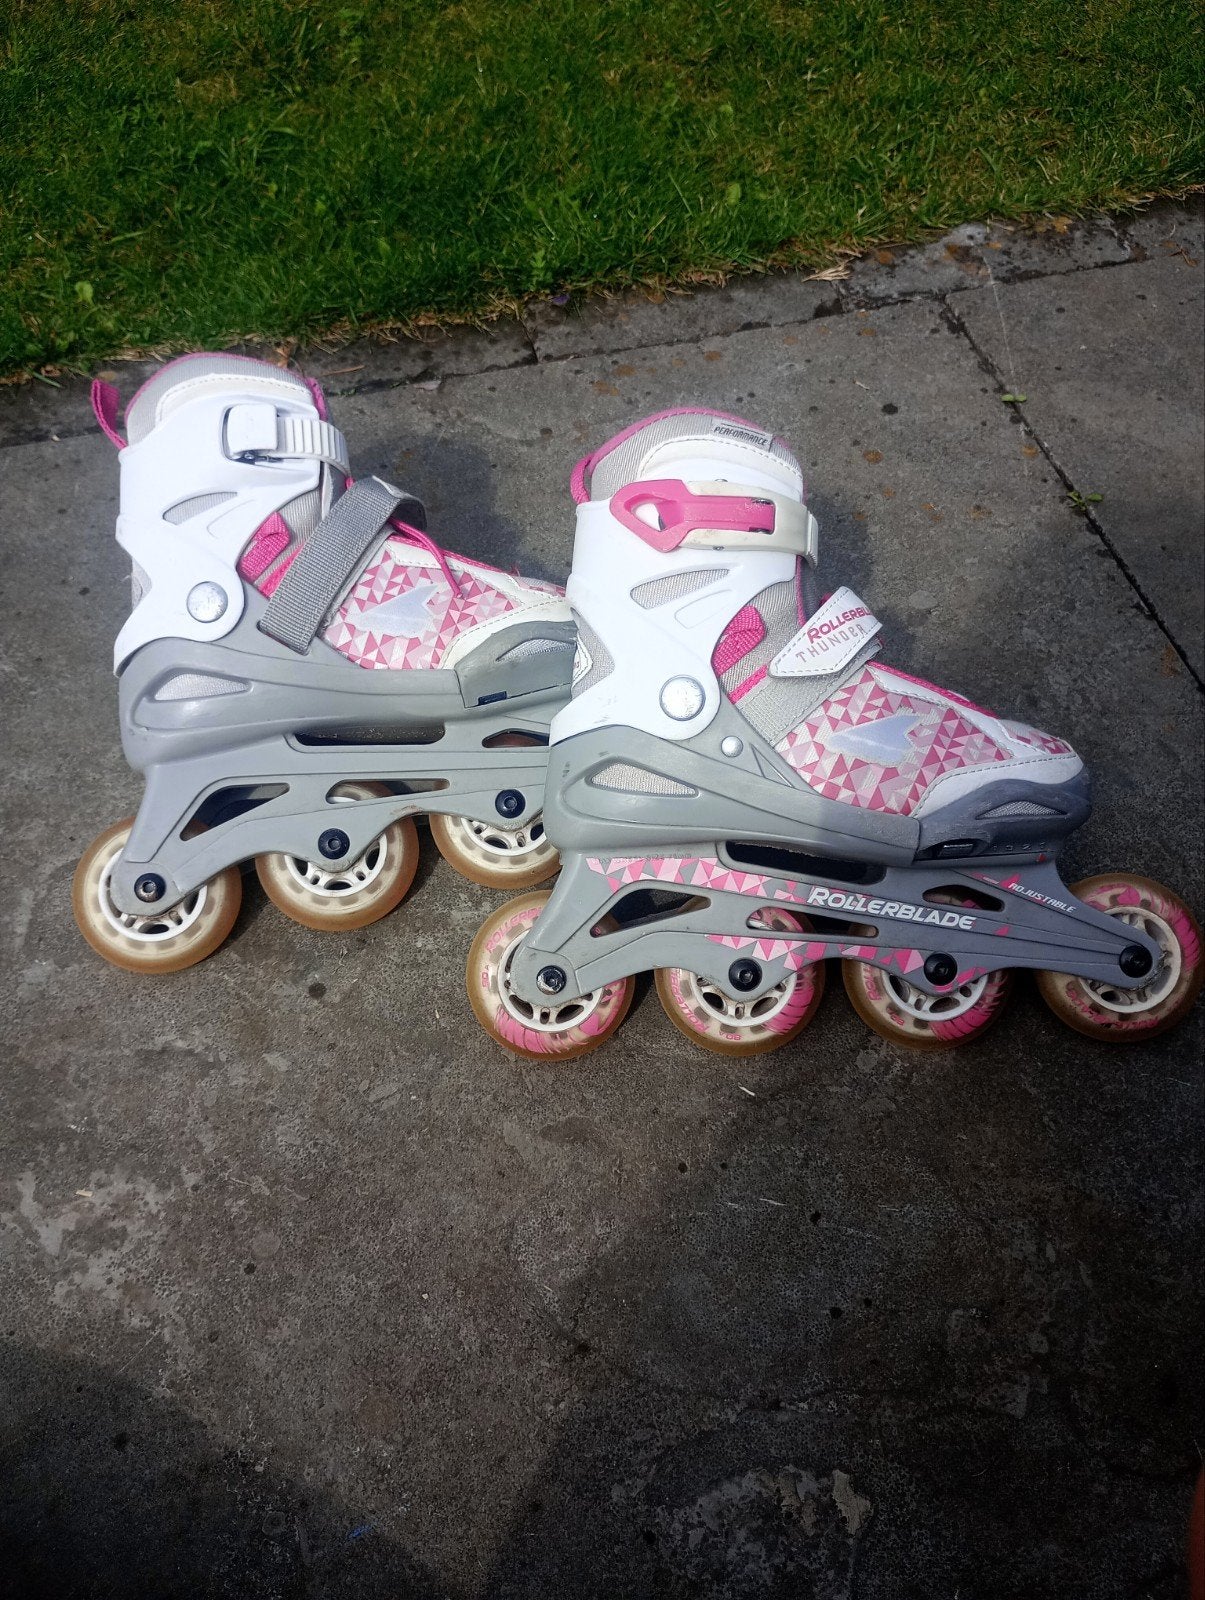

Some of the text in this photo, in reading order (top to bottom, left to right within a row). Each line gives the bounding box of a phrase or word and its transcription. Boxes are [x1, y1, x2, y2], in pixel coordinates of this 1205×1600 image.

[713, 426, 769, 446] PERFORMANCE
[795, 623, 868, 663] THUNDER
[806, 606, 873, 644] ROLLERBL
[806, 887, 978, 931] ROLLERBLADE
[1007, 882, 1077, 913] ADJUSTABLE
